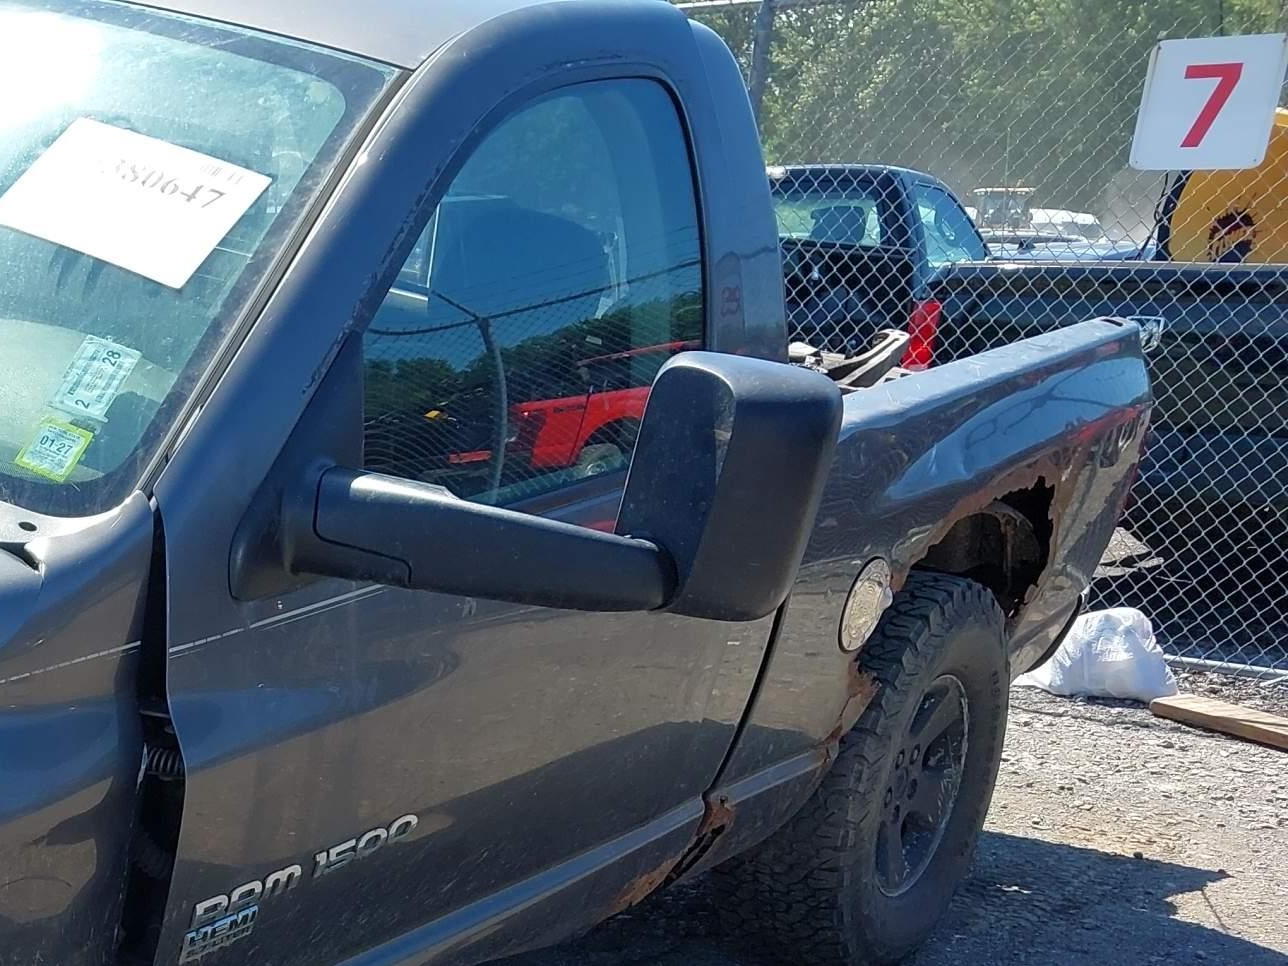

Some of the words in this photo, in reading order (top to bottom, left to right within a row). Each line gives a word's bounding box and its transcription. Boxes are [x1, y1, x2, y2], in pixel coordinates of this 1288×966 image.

[1181, 63, 1244, 148] 7
[75, 399, 91, 409] 2
[102, 350, 121, 367] 28
[39, 434, 74, 455] 01-27
[313, 814, 419, 878] 1500
[184, 904, 259, 946] HEMI
